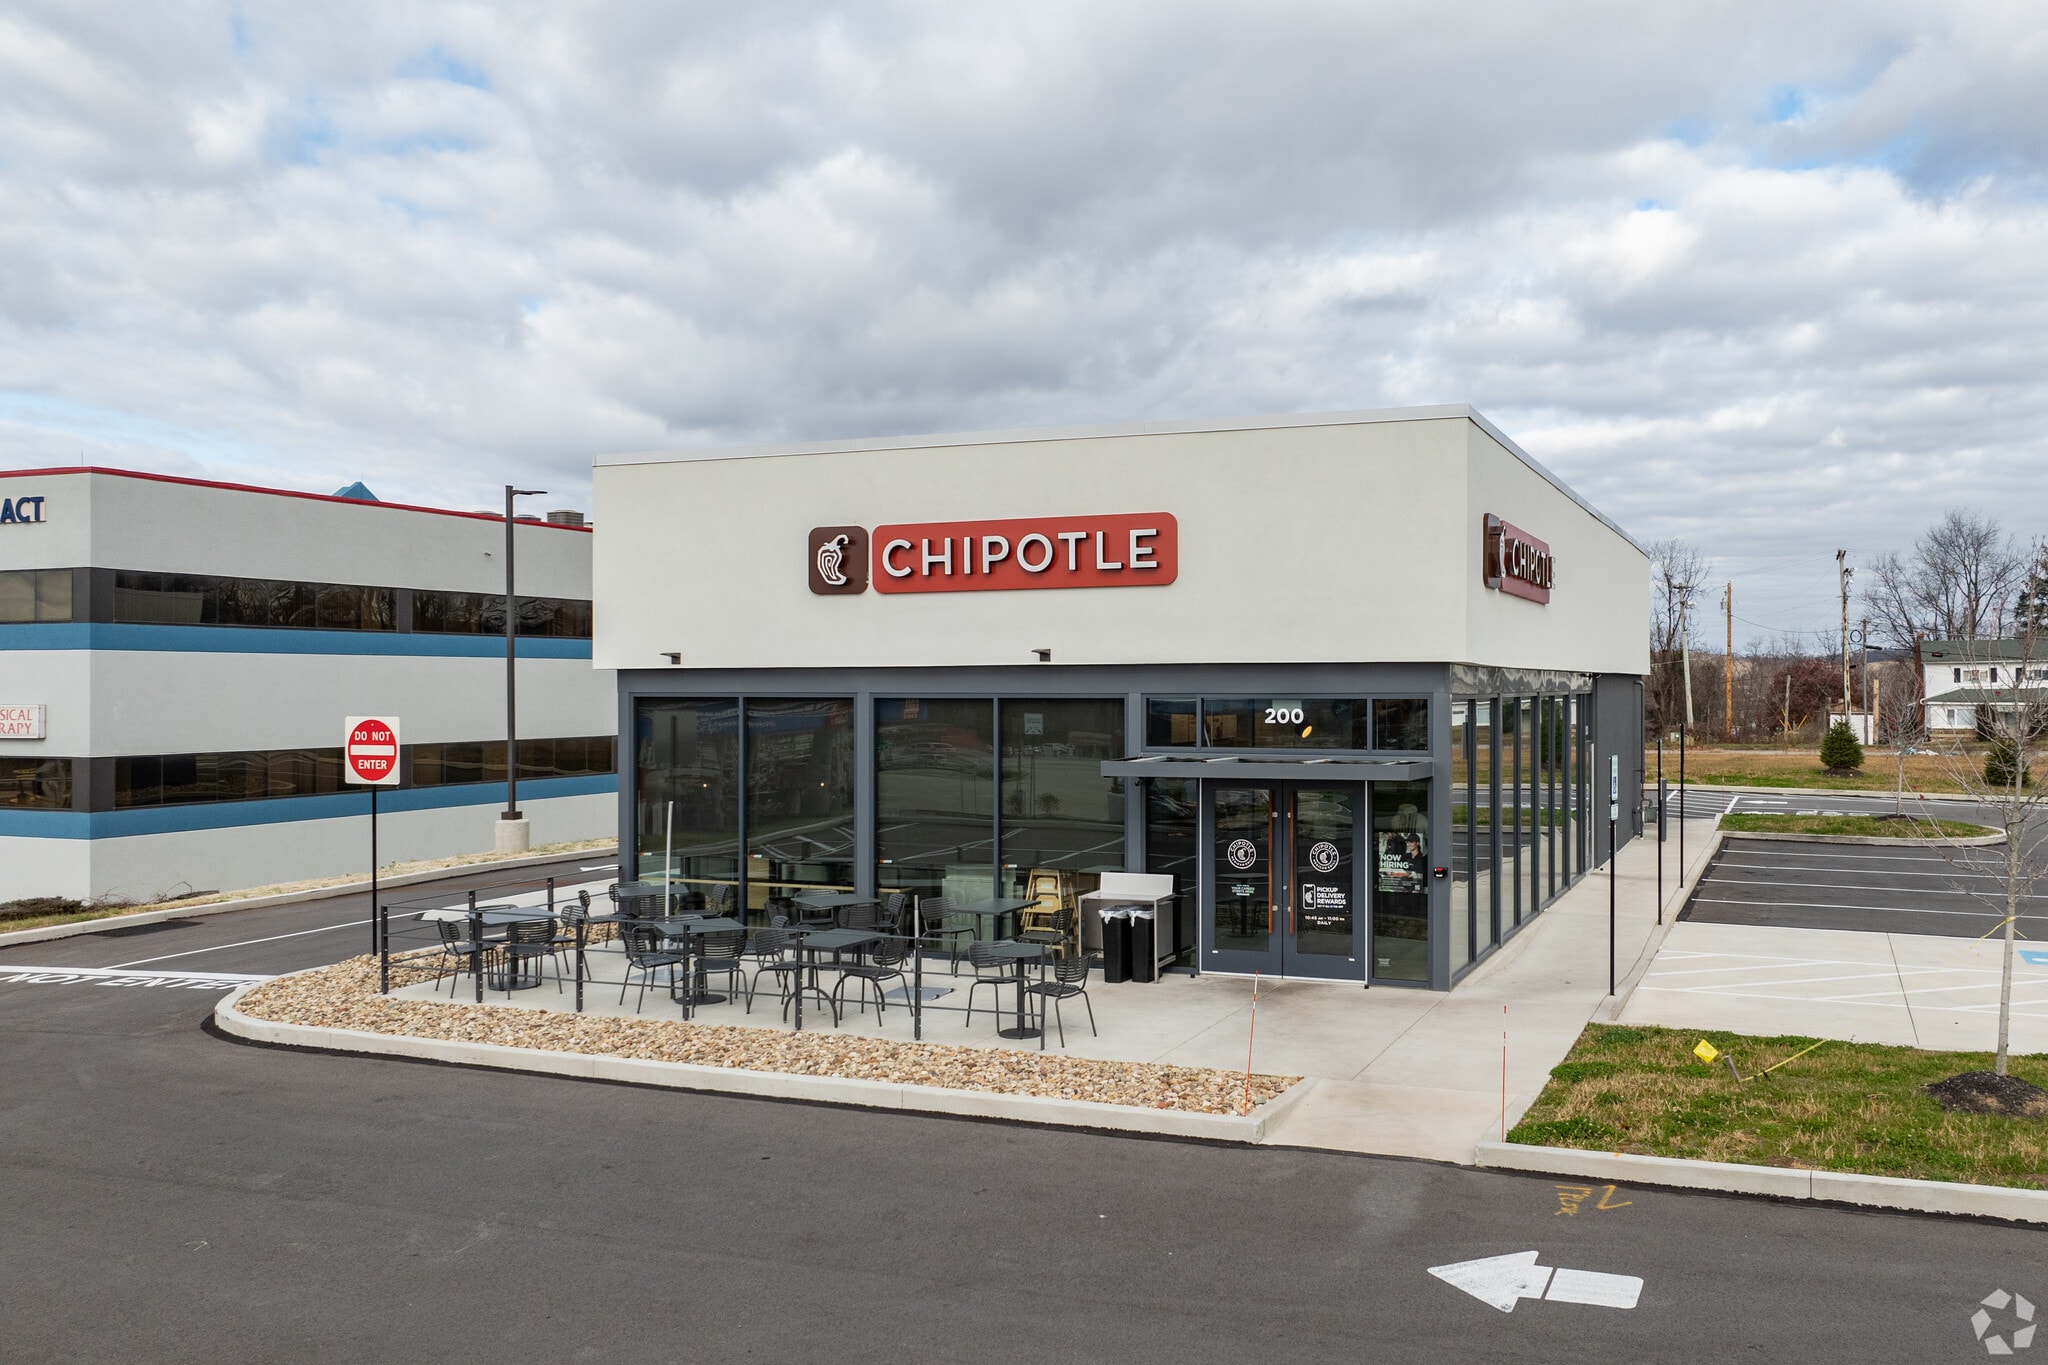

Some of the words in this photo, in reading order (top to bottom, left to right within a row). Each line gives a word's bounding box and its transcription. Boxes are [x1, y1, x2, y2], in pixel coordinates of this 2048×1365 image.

[0, 496, 44, 522] ACT
[882, 528, 1158, 578] CHIPOTLE
[0, 709, 32, 721] SICAL
[1264, 708, 1304, 724] 200
[0, 723, 32, 735] RAPY
[354, 731, 367, 741] DO
[372, 731, 391, 741] NOT
[358, 760, 387, 769] ENTER
[0, 973, 113, 985] NOT
